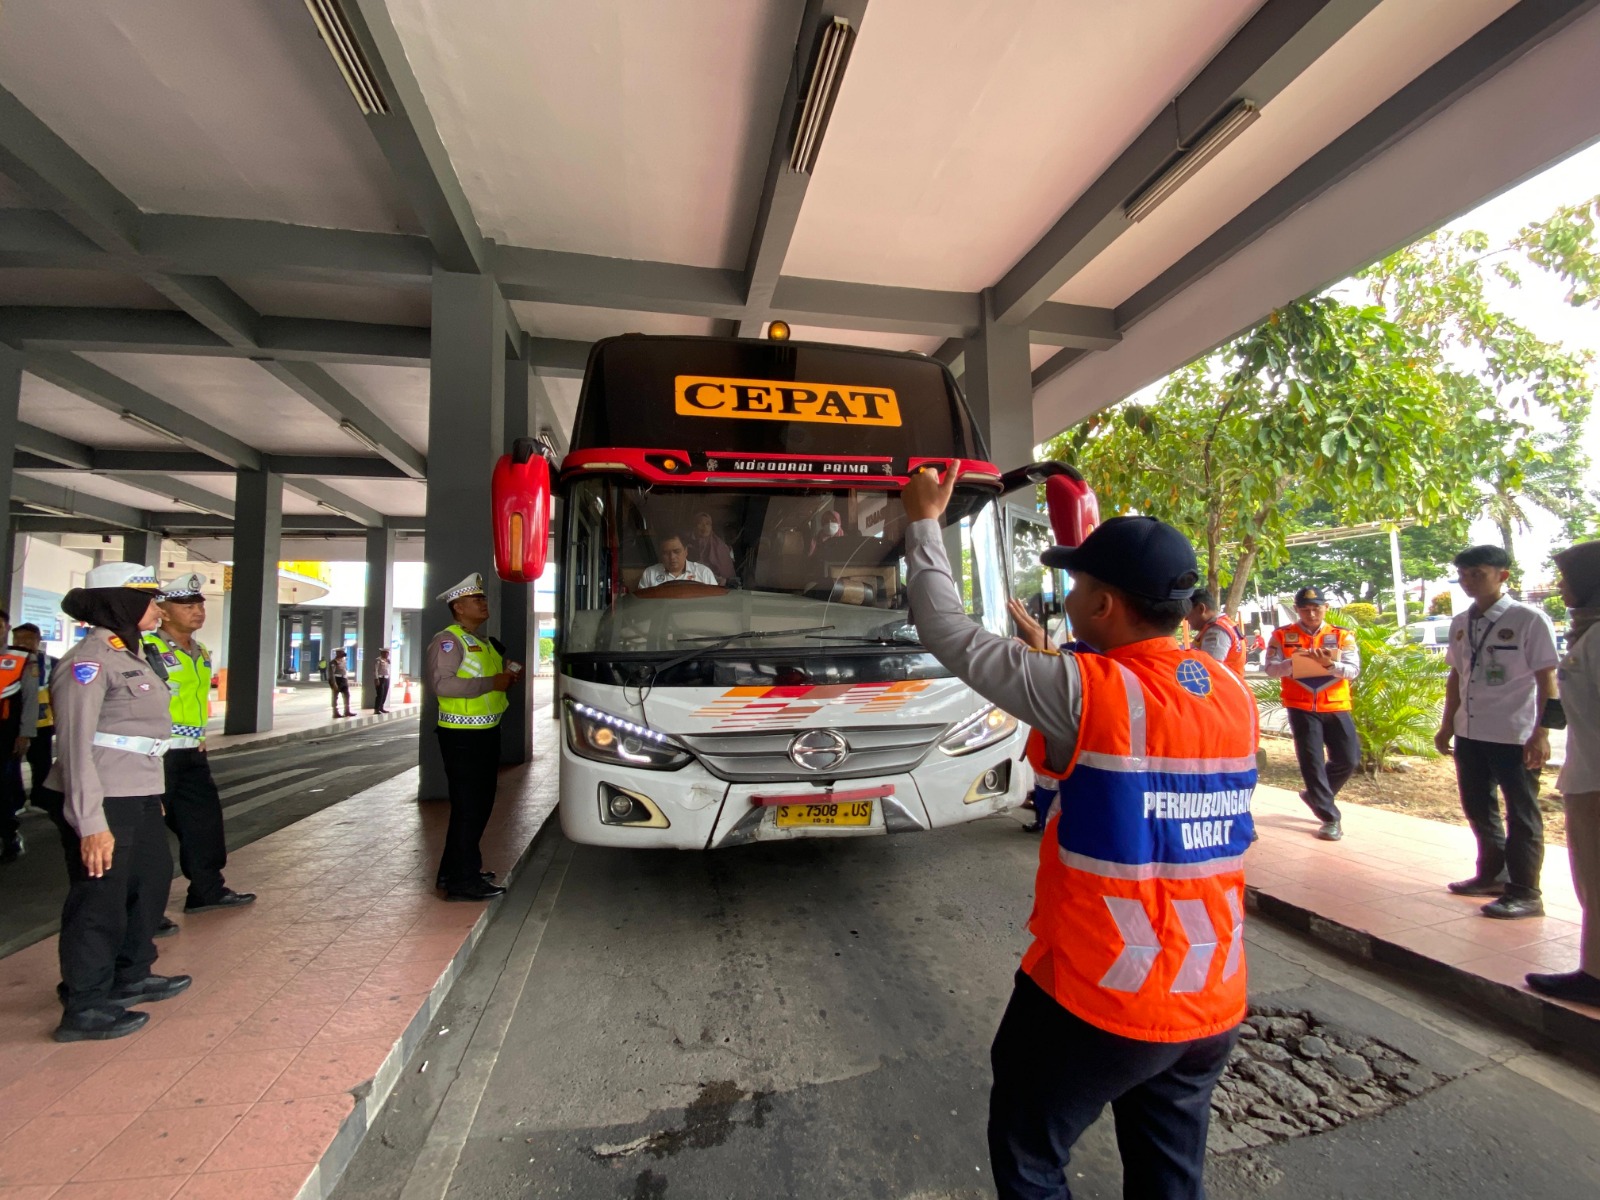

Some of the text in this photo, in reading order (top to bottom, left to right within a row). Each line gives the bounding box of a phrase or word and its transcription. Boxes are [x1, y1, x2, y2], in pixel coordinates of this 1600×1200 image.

[684, 382, 890, 420] CEPAT
[822, 463, 869, 474] PRIMA
[780, 803, 869, 817] S 7508 US
[1181, 820, 1233, 850] DARAT
